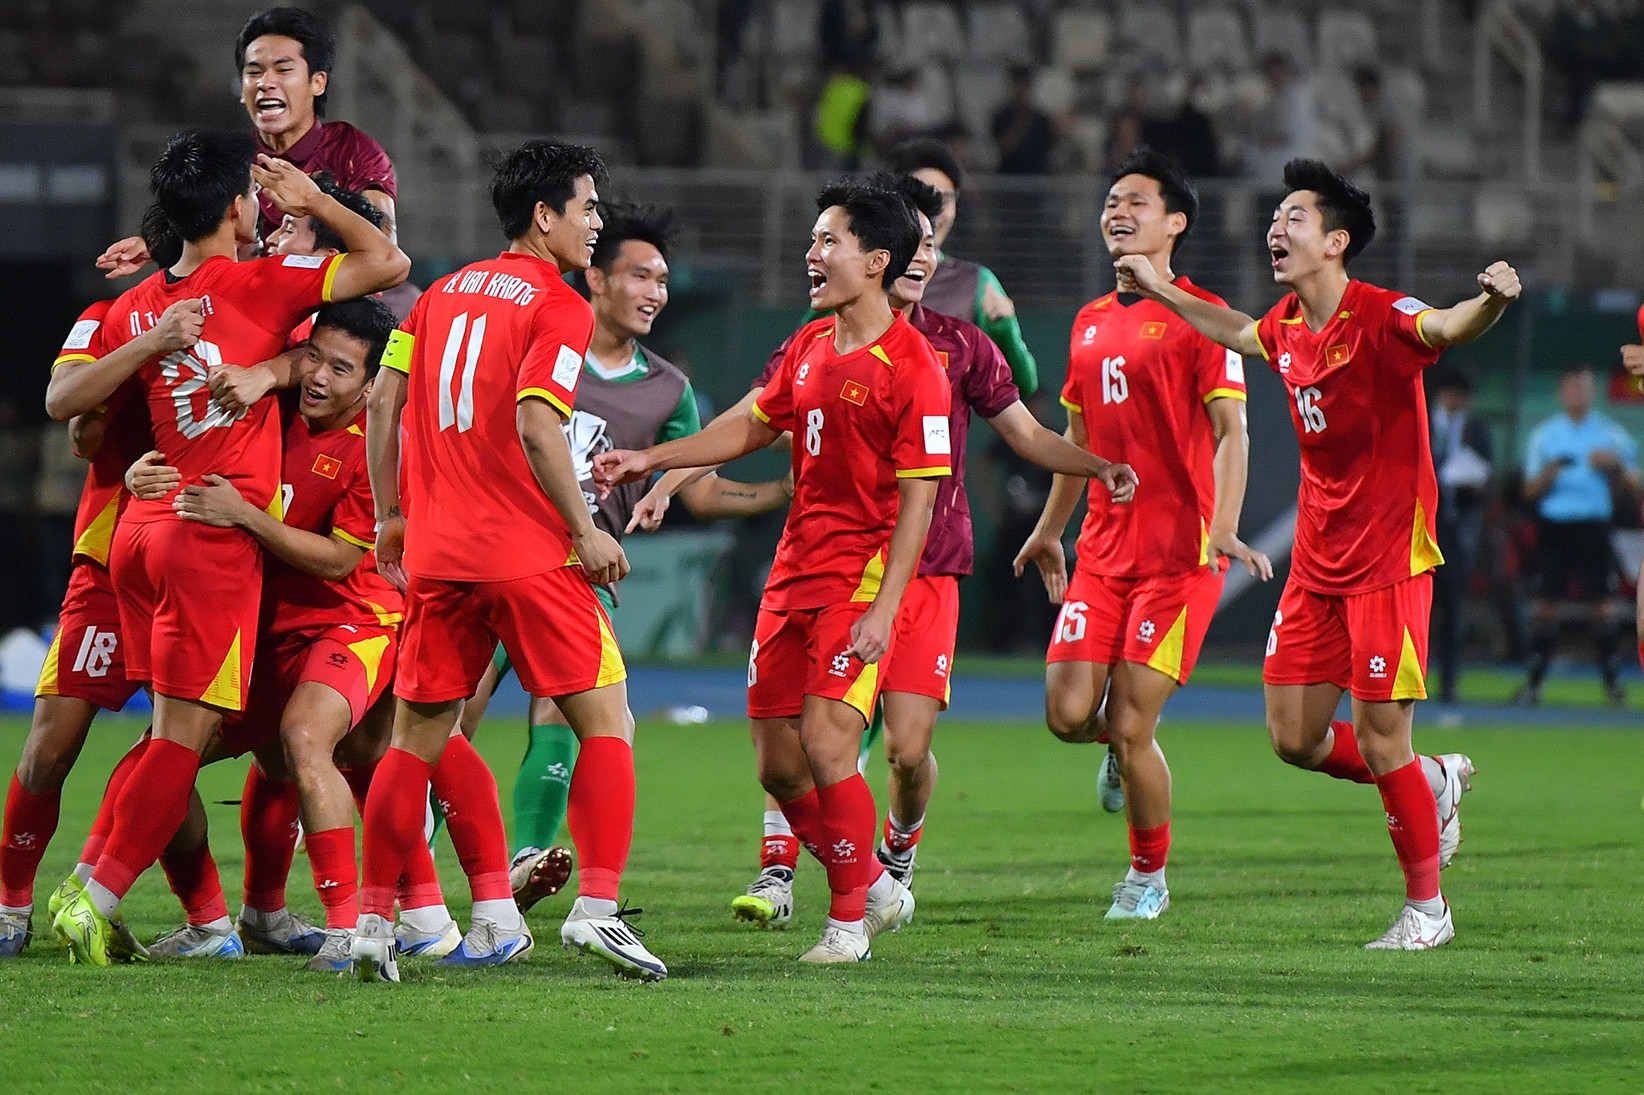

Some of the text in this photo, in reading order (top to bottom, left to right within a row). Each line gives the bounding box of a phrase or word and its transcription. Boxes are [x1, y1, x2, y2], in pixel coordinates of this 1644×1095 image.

[483, 272, 540, 307] KHANG
[438, 310, 488, 434] 11
[1102, 355, 1129, 405] 15
[806, 408, 825, 457] 8
[1294, 386, 1328, 434] 16
[1054, 601, 1090, 645] 15
[72, 625, 118, 677] 18
